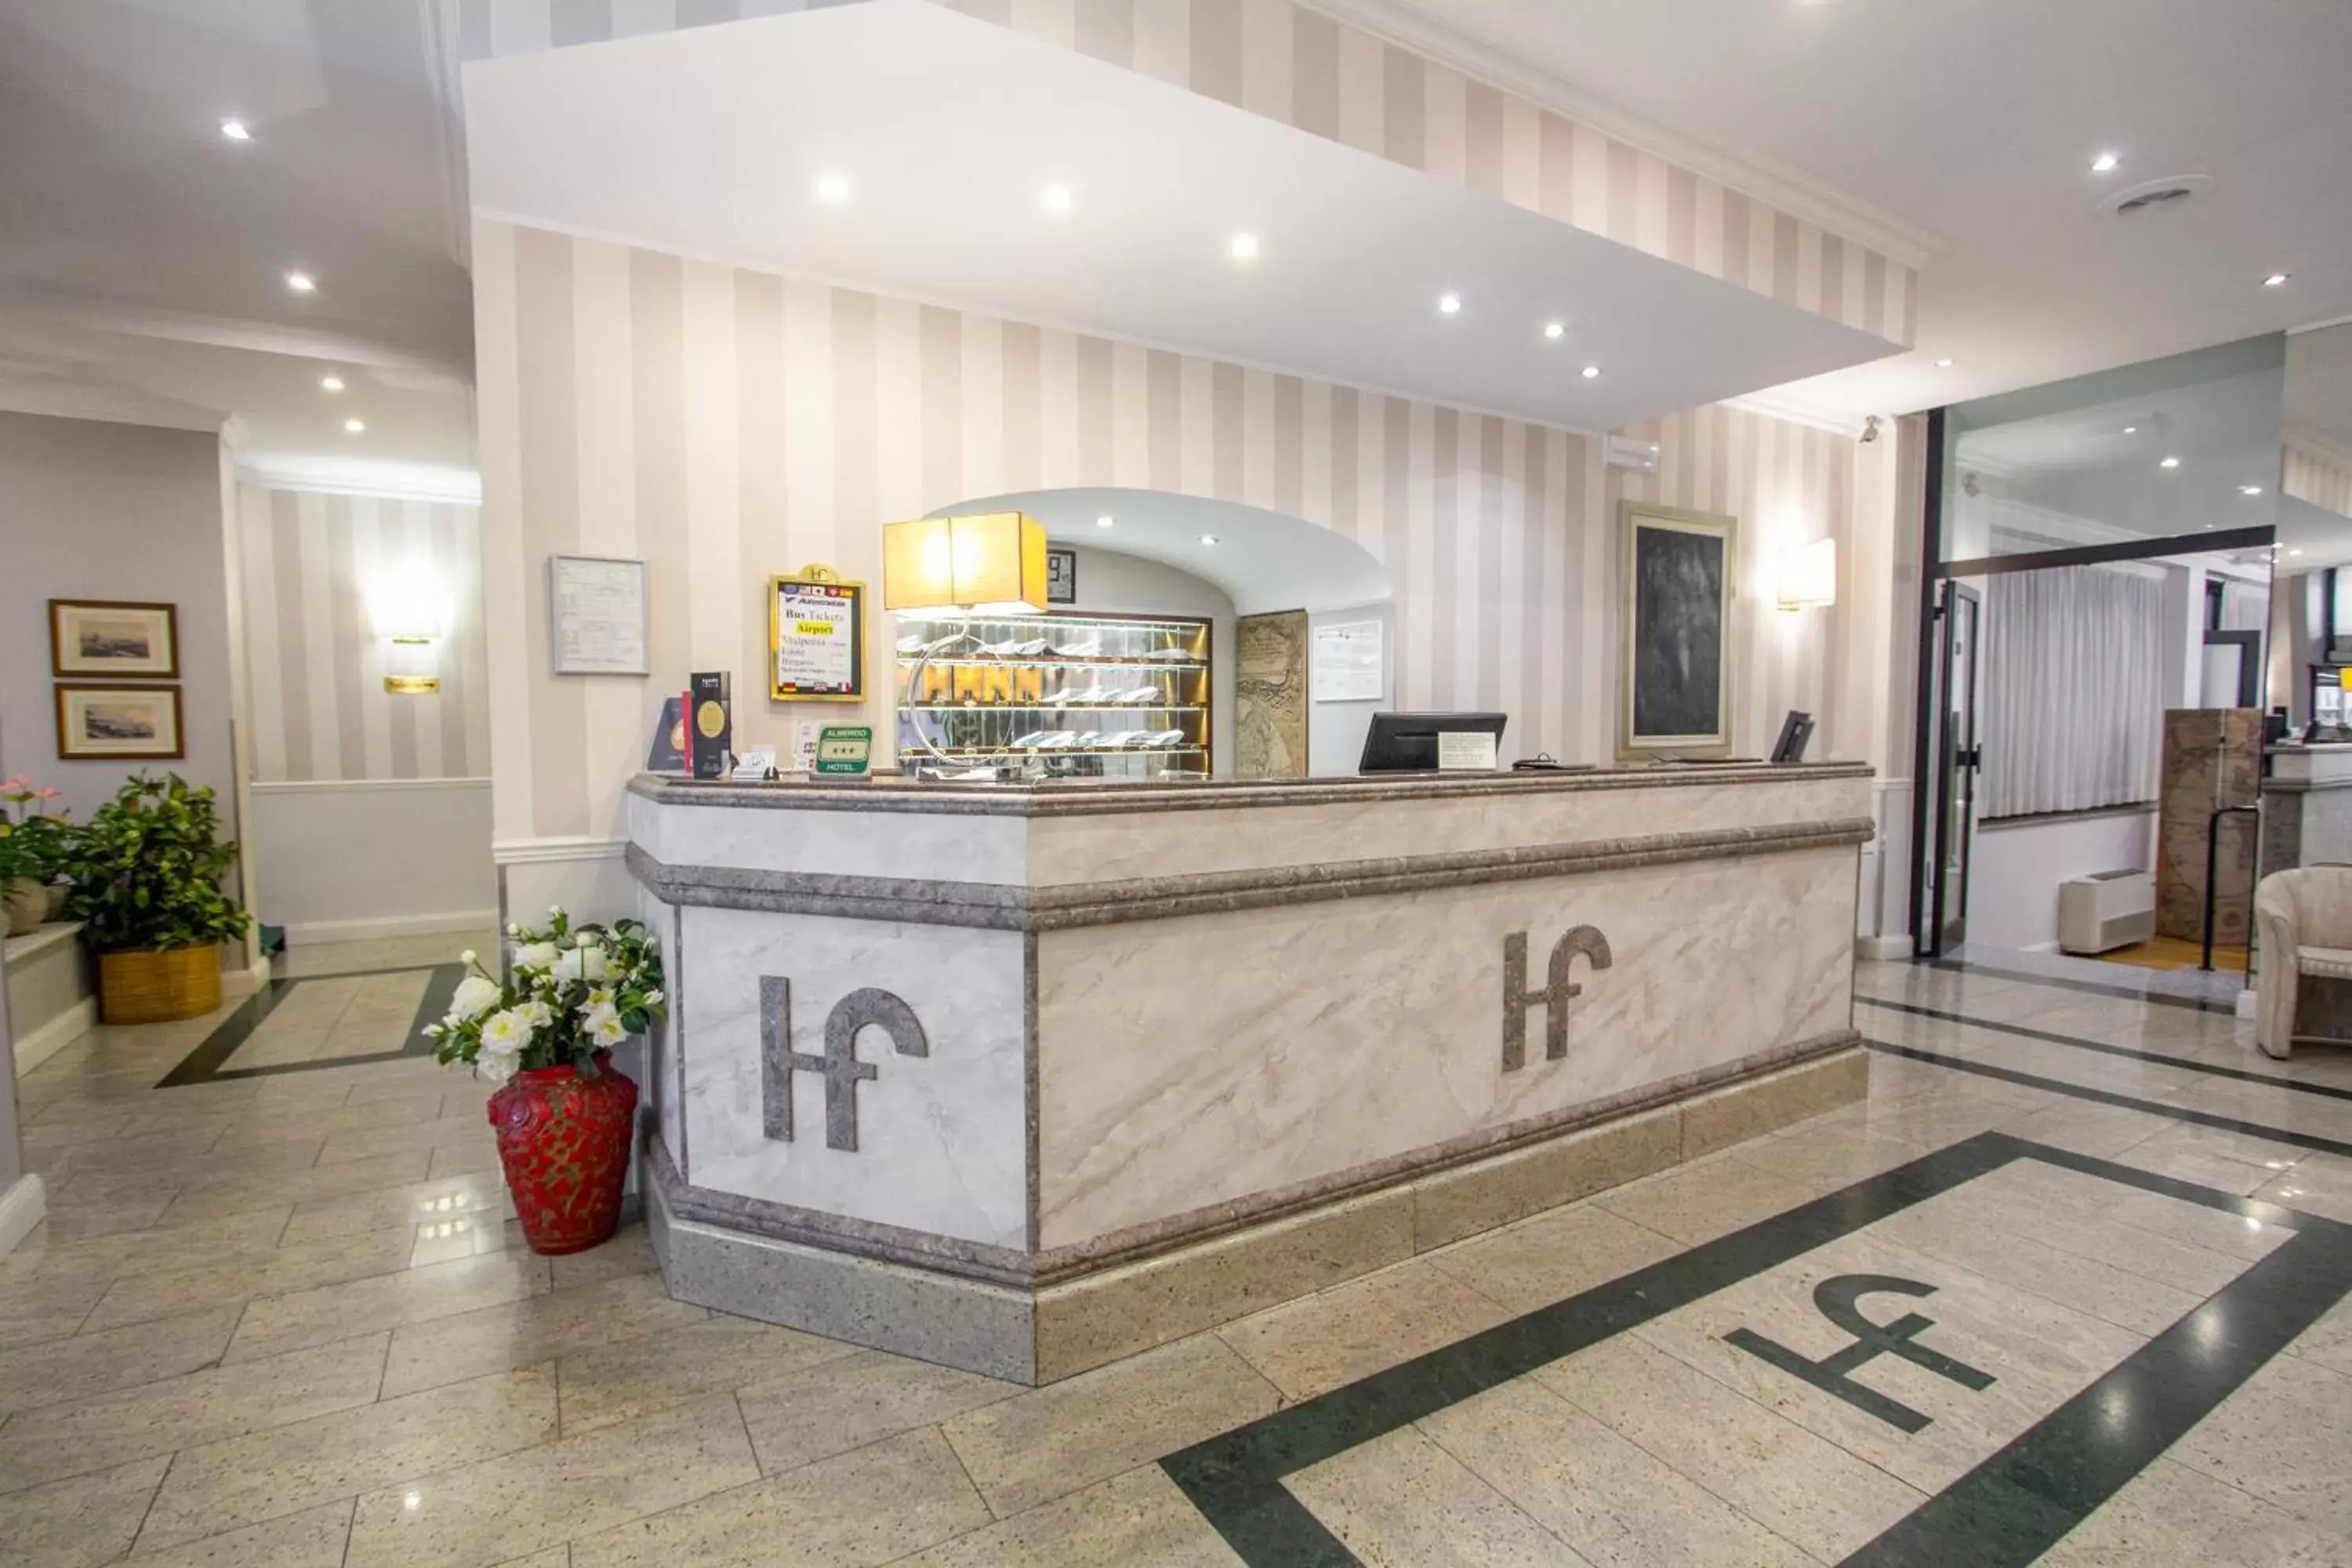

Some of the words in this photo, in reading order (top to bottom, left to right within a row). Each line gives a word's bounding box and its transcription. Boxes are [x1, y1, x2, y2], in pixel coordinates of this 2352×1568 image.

[786, 609, 805, 619] Bus
[810, 611, 844, 621] Tickets
[797, 624, 833, 635] Airport
